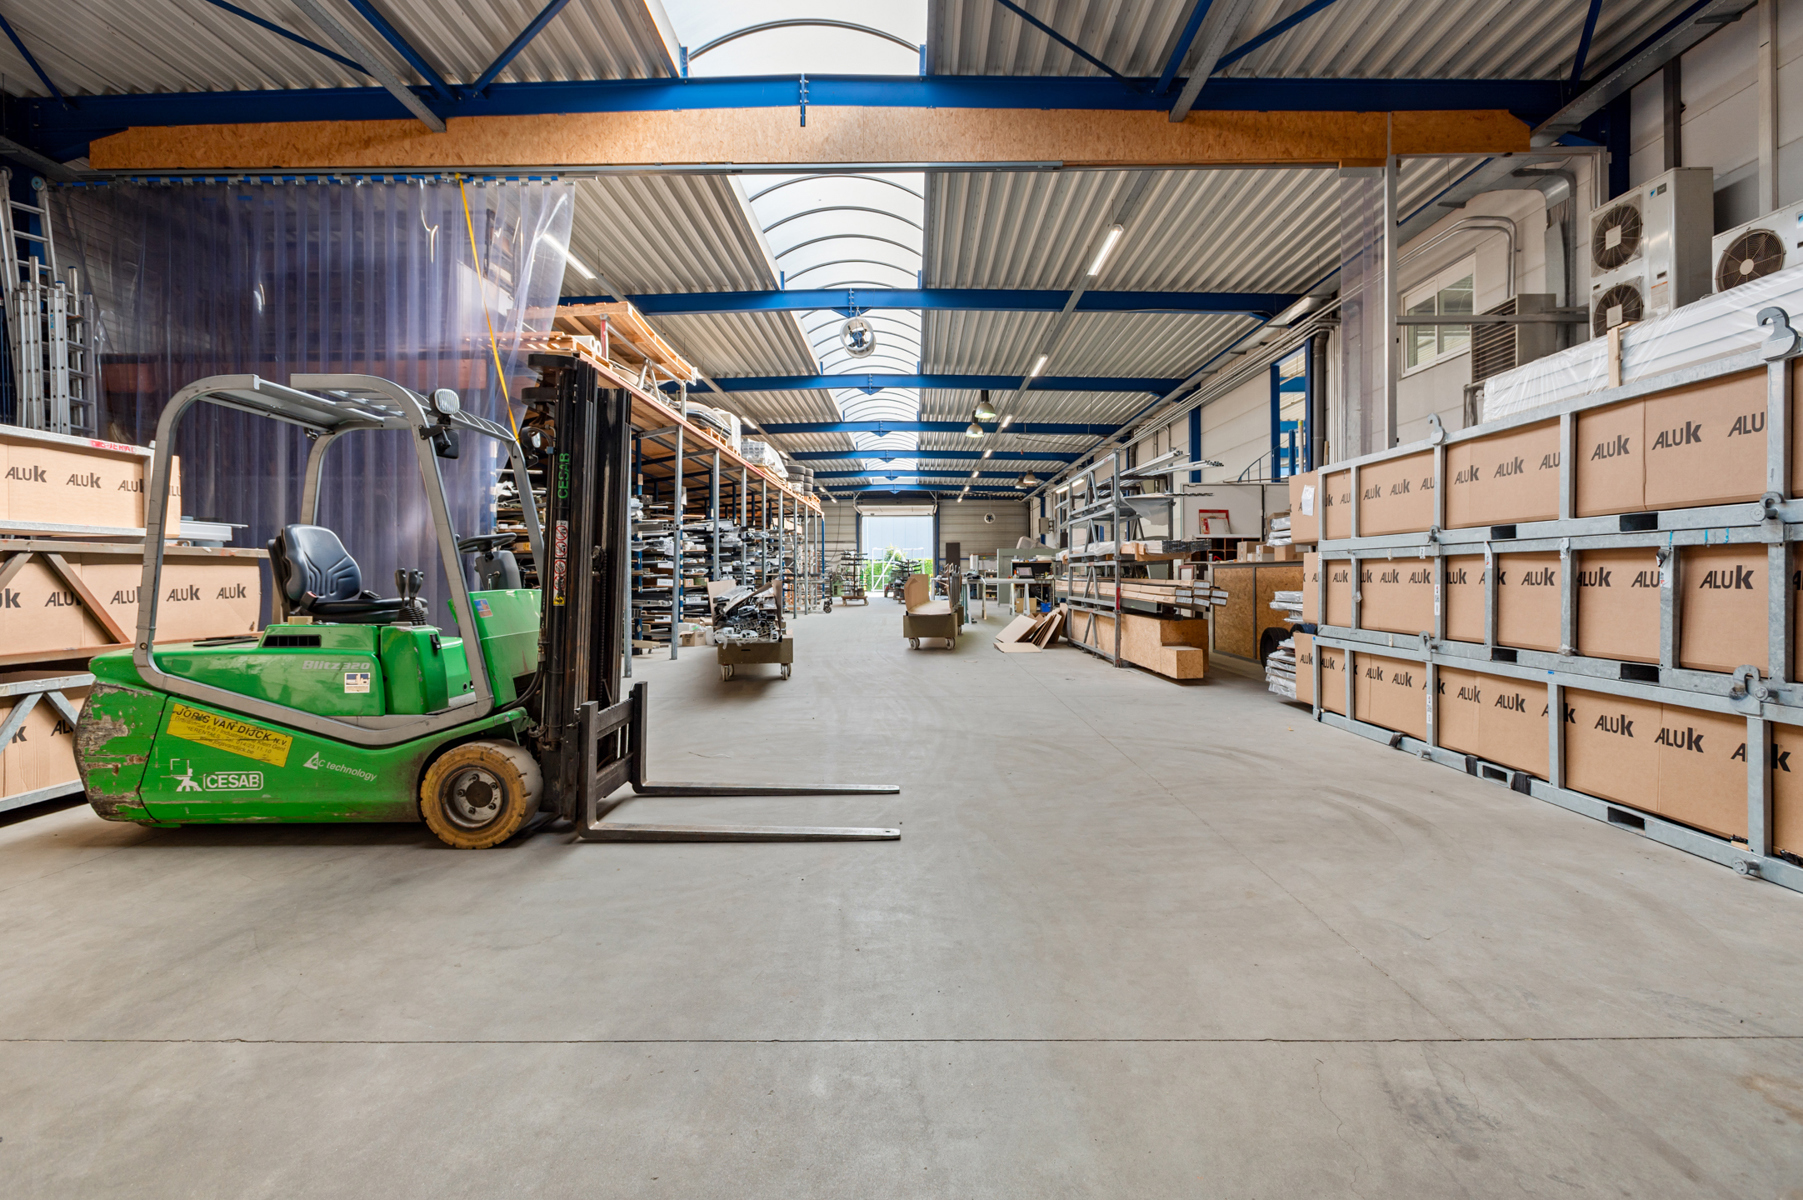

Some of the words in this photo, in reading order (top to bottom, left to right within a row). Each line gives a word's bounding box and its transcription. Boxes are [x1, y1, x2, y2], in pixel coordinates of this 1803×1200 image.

[557, 452, 570, 499] CESAB
[302, 660, 340, 670] Blitz
[342, 662, 370, 670] 320
[213, 718, 236, 731] VAN
[237, 725, 272, 741] DIJCK
[206, 774, 260, 788] CESAB
[326, 761, 378, 782] technology
